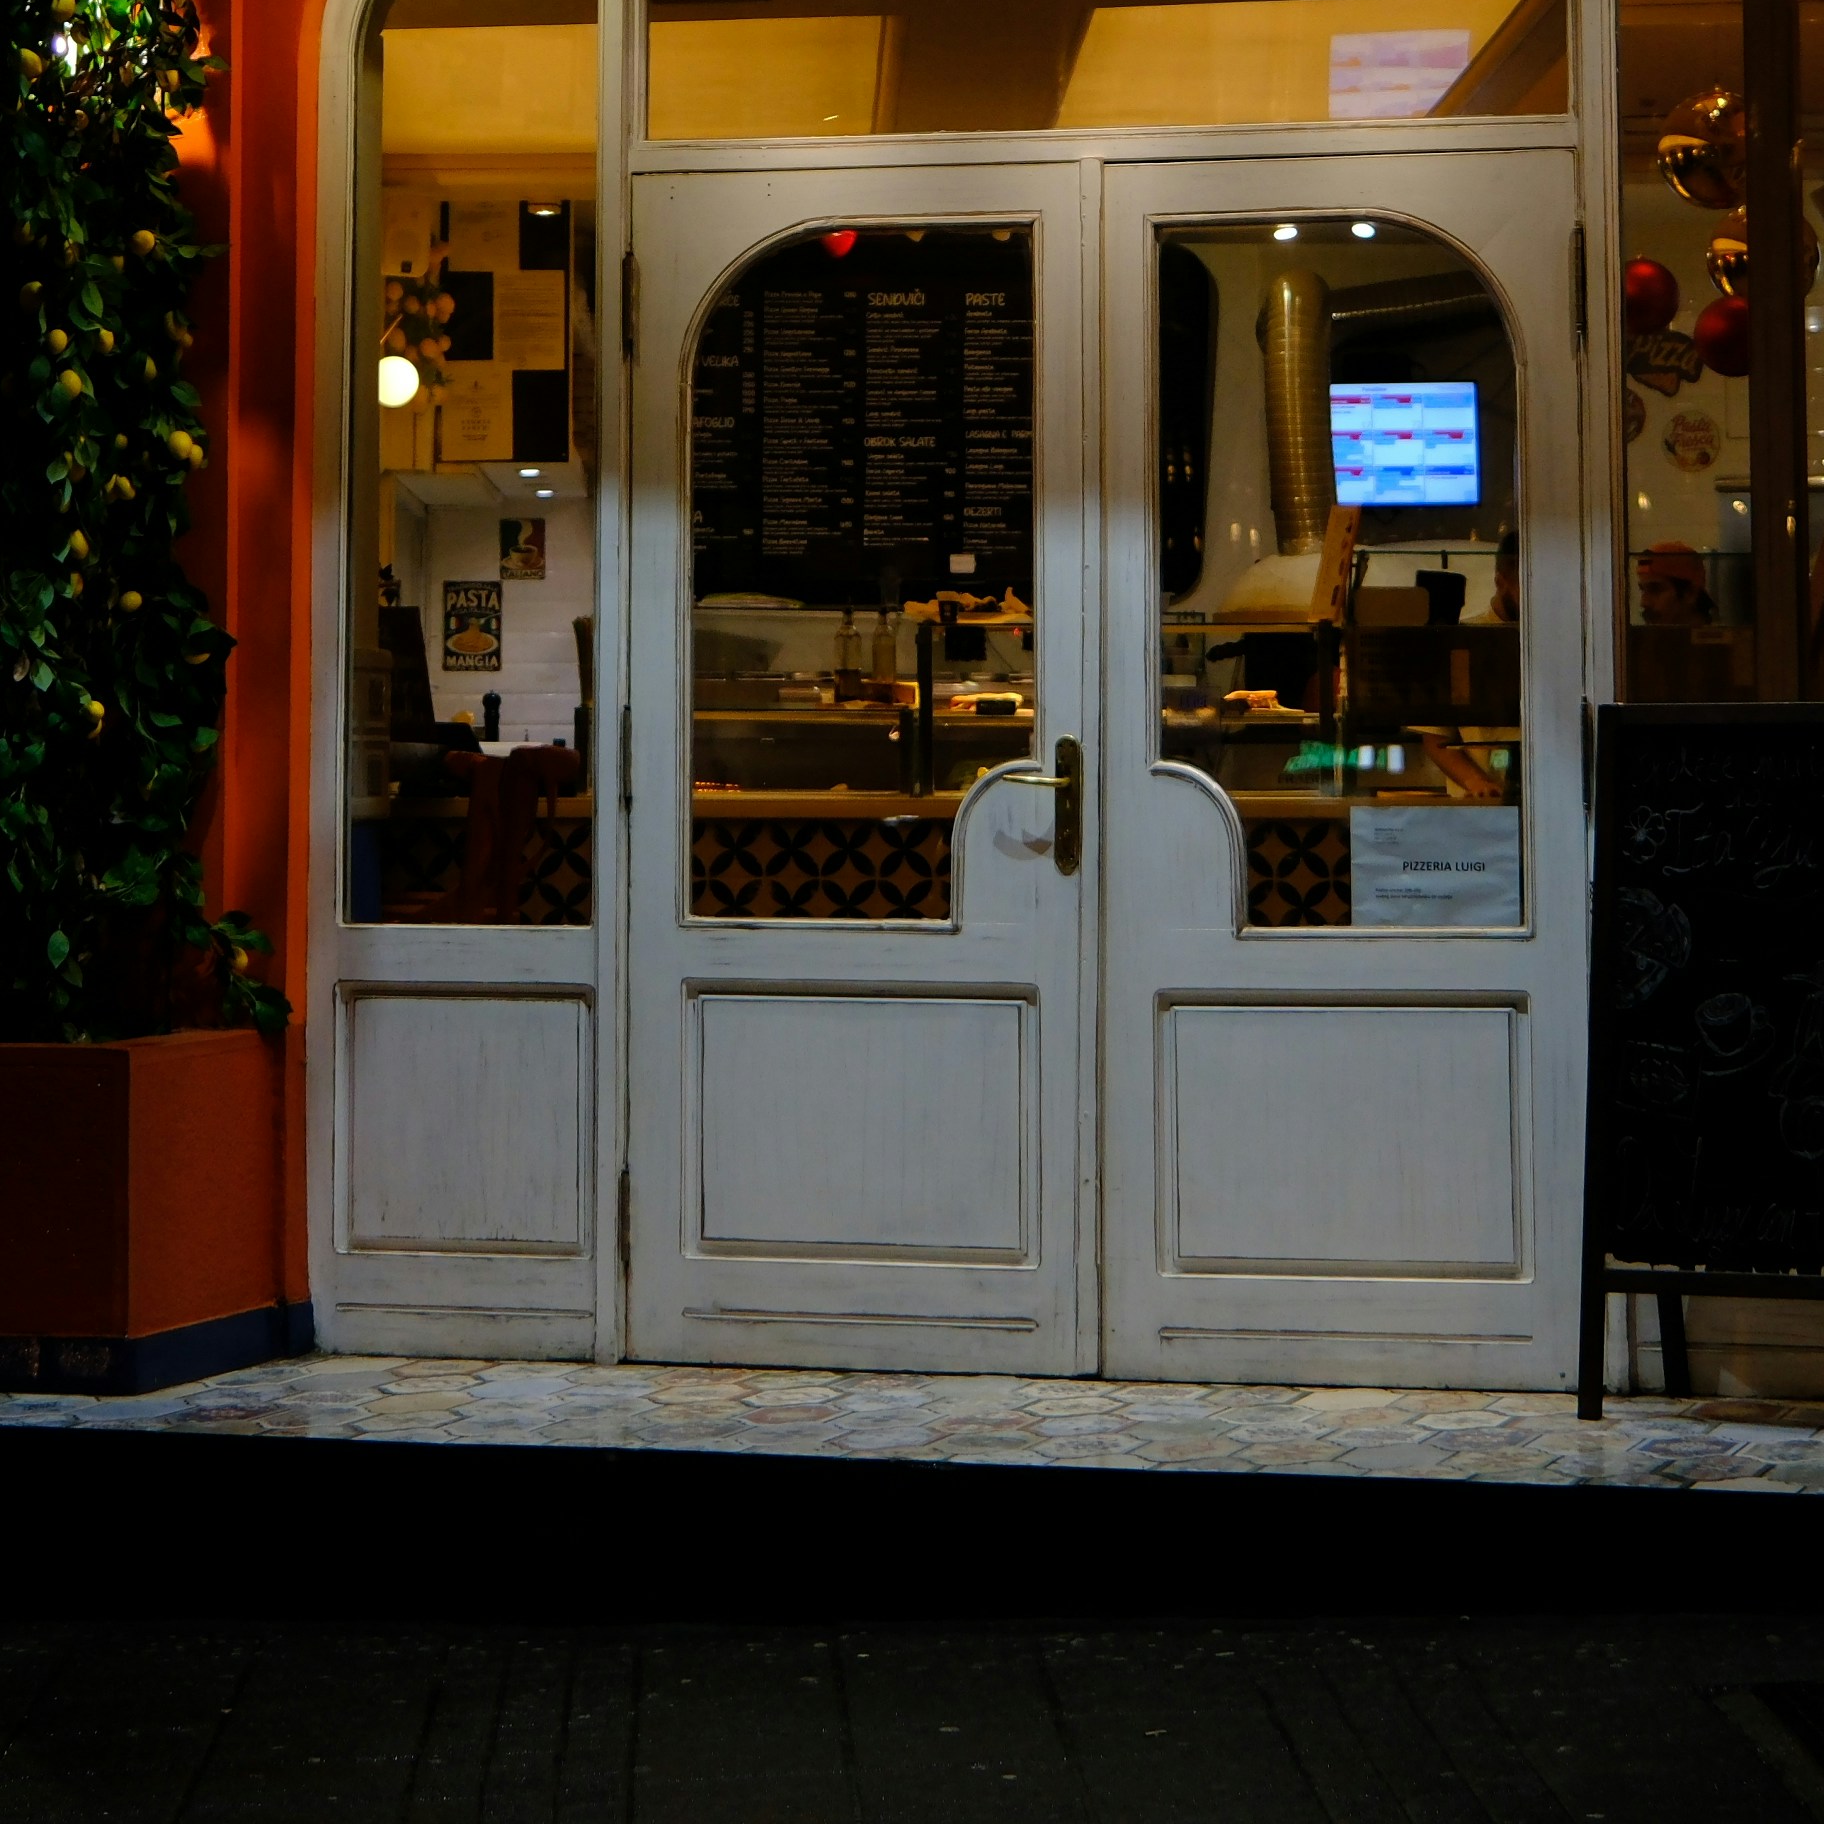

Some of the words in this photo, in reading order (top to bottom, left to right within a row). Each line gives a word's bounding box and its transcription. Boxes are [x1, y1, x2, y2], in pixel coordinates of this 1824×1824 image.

[866, 288, 925, 307] SENDVIČI
[964, 292, 1006, 307] PASTE
[701, 355, 740, 367] VELIKA
[899, 435, 937, 448] SALATE
[446, 589, 500, 612] PASTA
[446, 654, 499, 667] MANGIA
[1402, 861, 1452, 872] PIZZERIA
[1455, 861, 1486, 872] LUIGI
